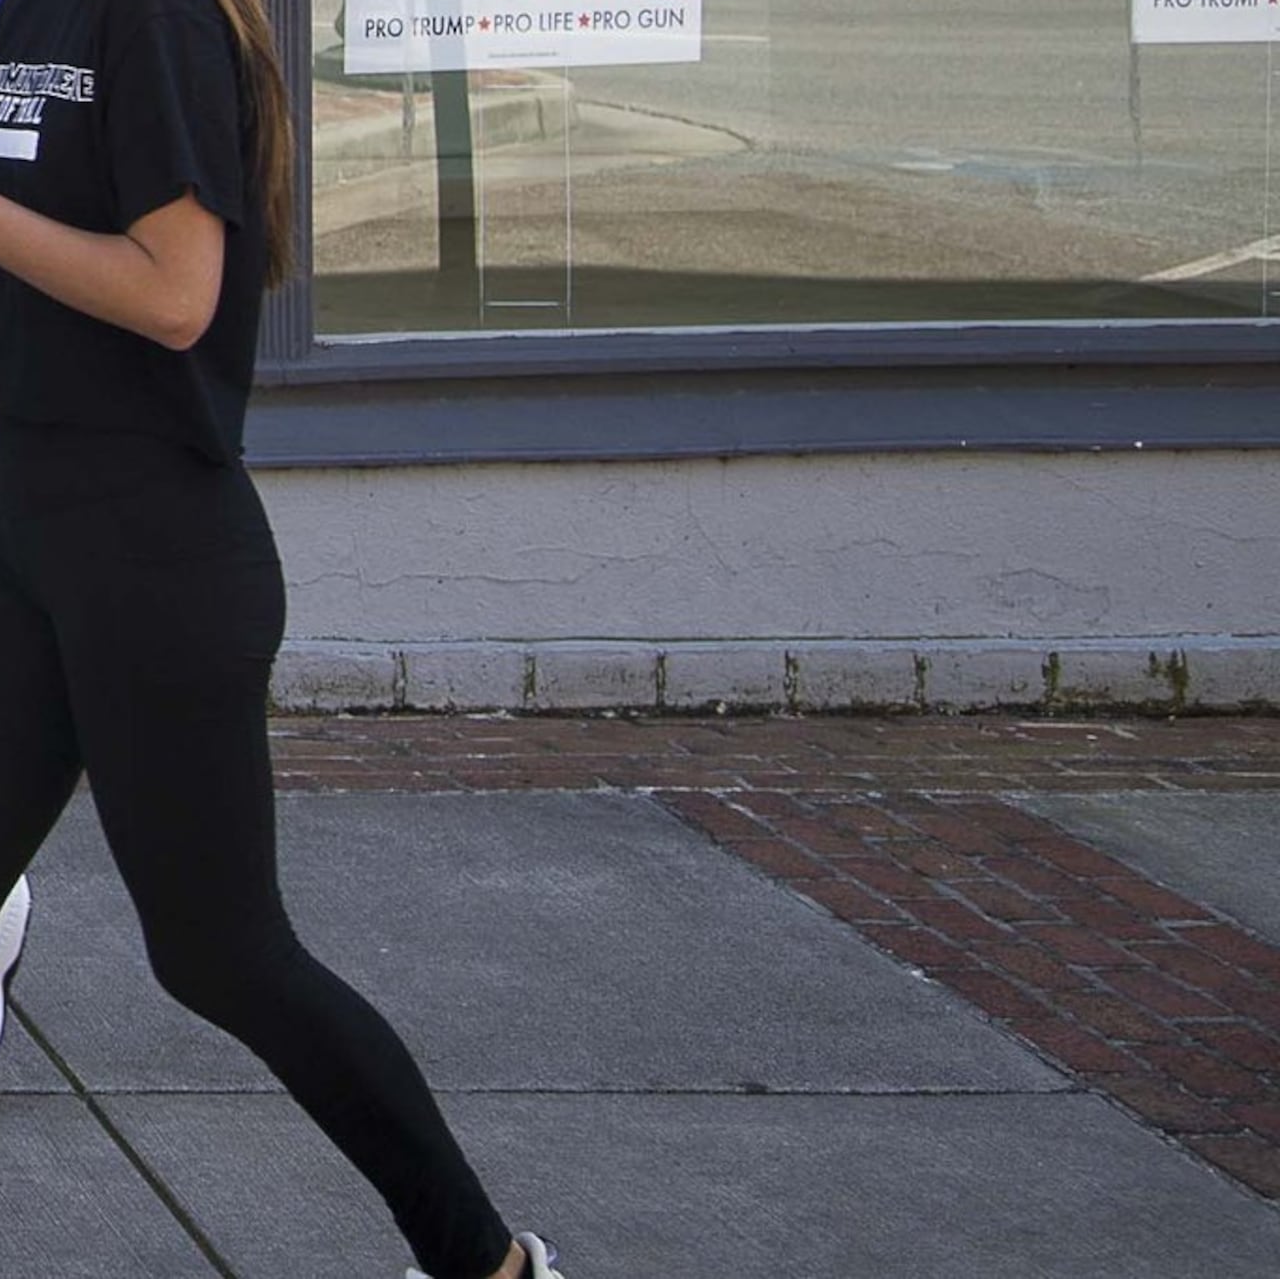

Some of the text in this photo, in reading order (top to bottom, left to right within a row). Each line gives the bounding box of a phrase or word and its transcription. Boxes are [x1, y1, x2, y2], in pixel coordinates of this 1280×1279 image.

[365, 9, 685, 38] PRO TRUMP PRO LIFE PRO GUN
